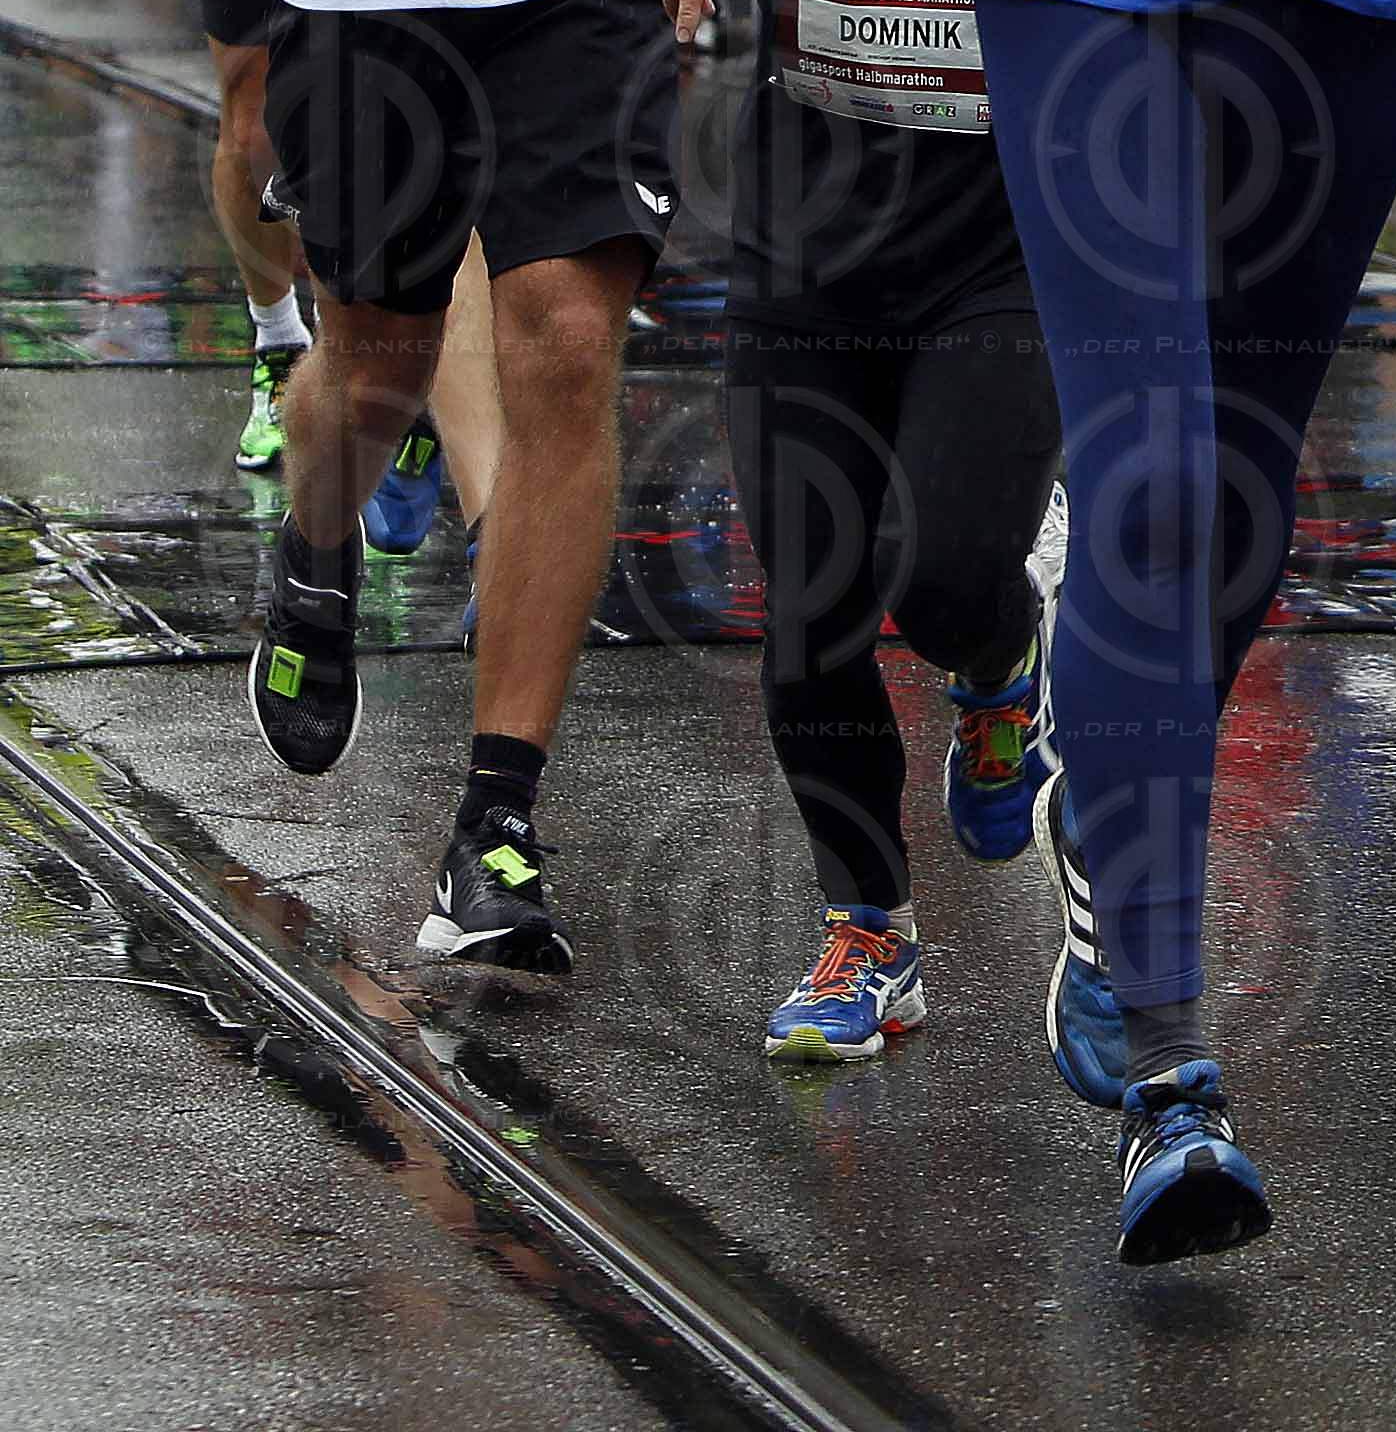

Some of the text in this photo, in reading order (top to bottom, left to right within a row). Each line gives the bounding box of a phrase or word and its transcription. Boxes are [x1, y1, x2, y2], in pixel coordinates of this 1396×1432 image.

[839, 14, 963, 50] DOMINIK
[799, 58, 944, 88] gigasport Halbmarathon
[912, 103, 956, 118] GRAZ
